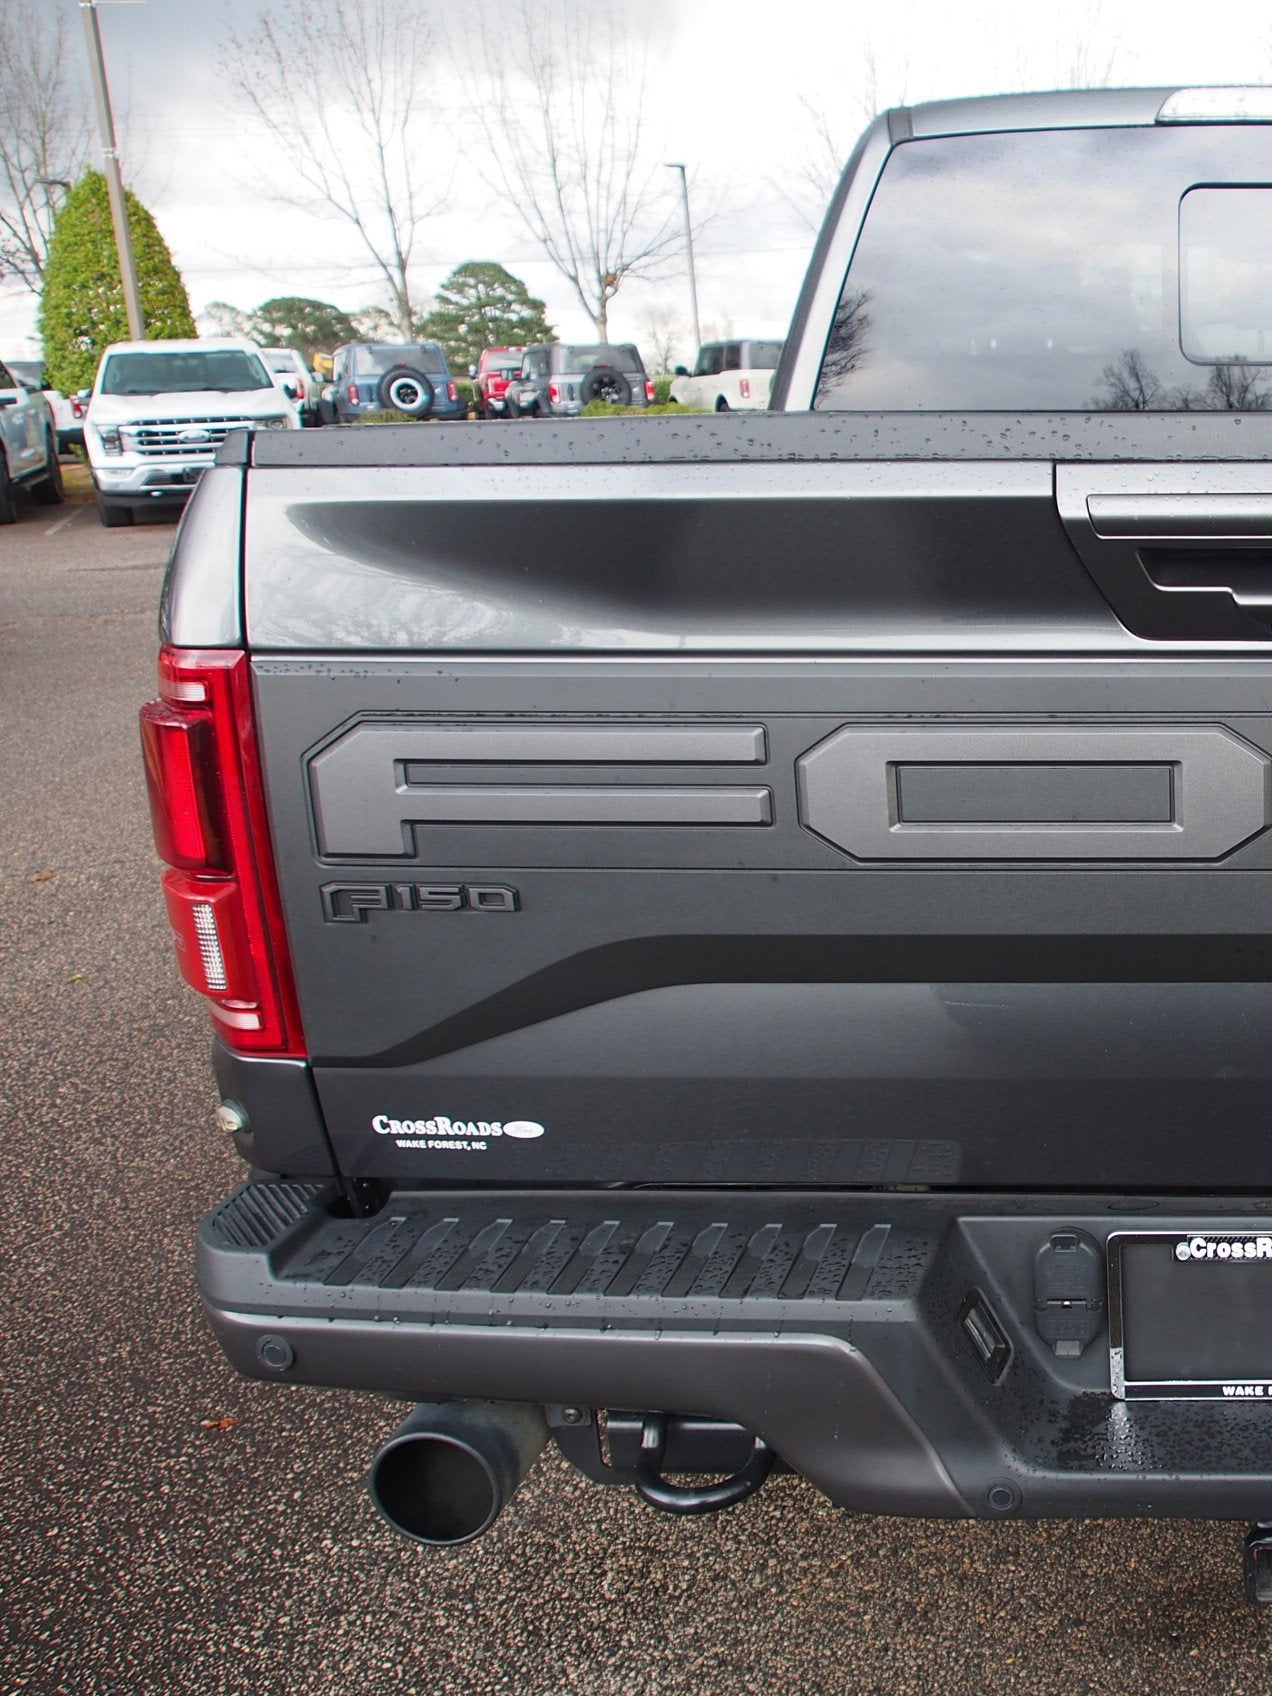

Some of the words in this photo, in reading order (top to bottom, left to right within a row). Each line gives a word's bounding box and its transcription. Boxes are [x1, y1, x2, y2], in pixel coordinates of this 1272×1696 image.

[319, 880, 521, 923] F150
[395, 1140, 427, 1149] WAKE
[428, 1140, 471, 1151] FOREST,
[471, 1141, 487, 1150] NC
[1222, 1385, 1263, 1396] WAKE
